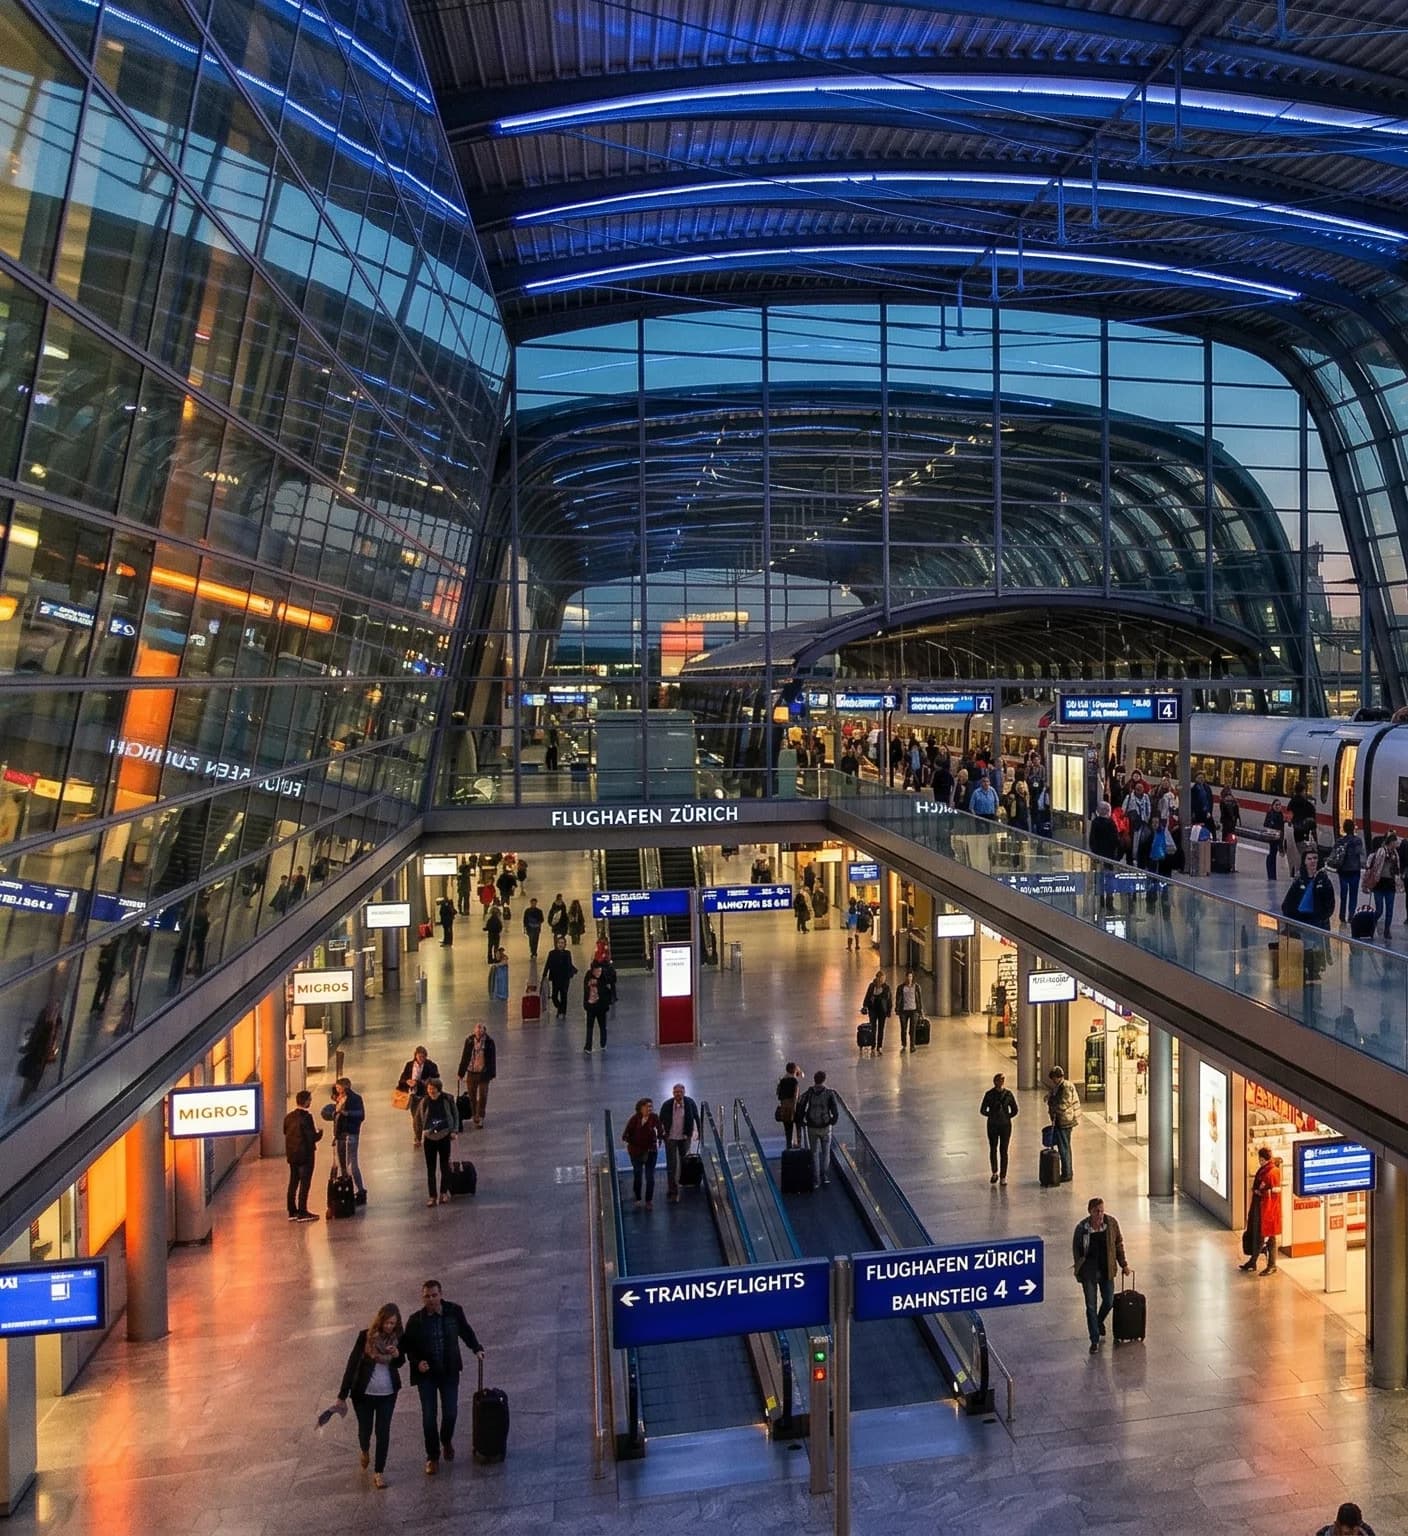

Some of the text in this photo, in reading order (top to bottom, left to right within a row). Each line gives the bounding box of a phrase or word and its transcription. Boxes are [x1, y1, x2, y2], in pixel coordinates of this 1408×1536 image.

[1163, 703, 1173, 718] 4
[552, 804, 738, 827] FLUGHAFEN ZÜRICH
[297, 982, 349, 994] MIGROS
[178, 1104, 249, 1121] MIGROS
[866, 1248, 1037, 1281] FLUGHAFEN ZÜRICH
[645, 1272, 805, 1304] TRAINS/FLIGHTS
[892, 1279, 1008, 1311] BAHNSTEIG 4
